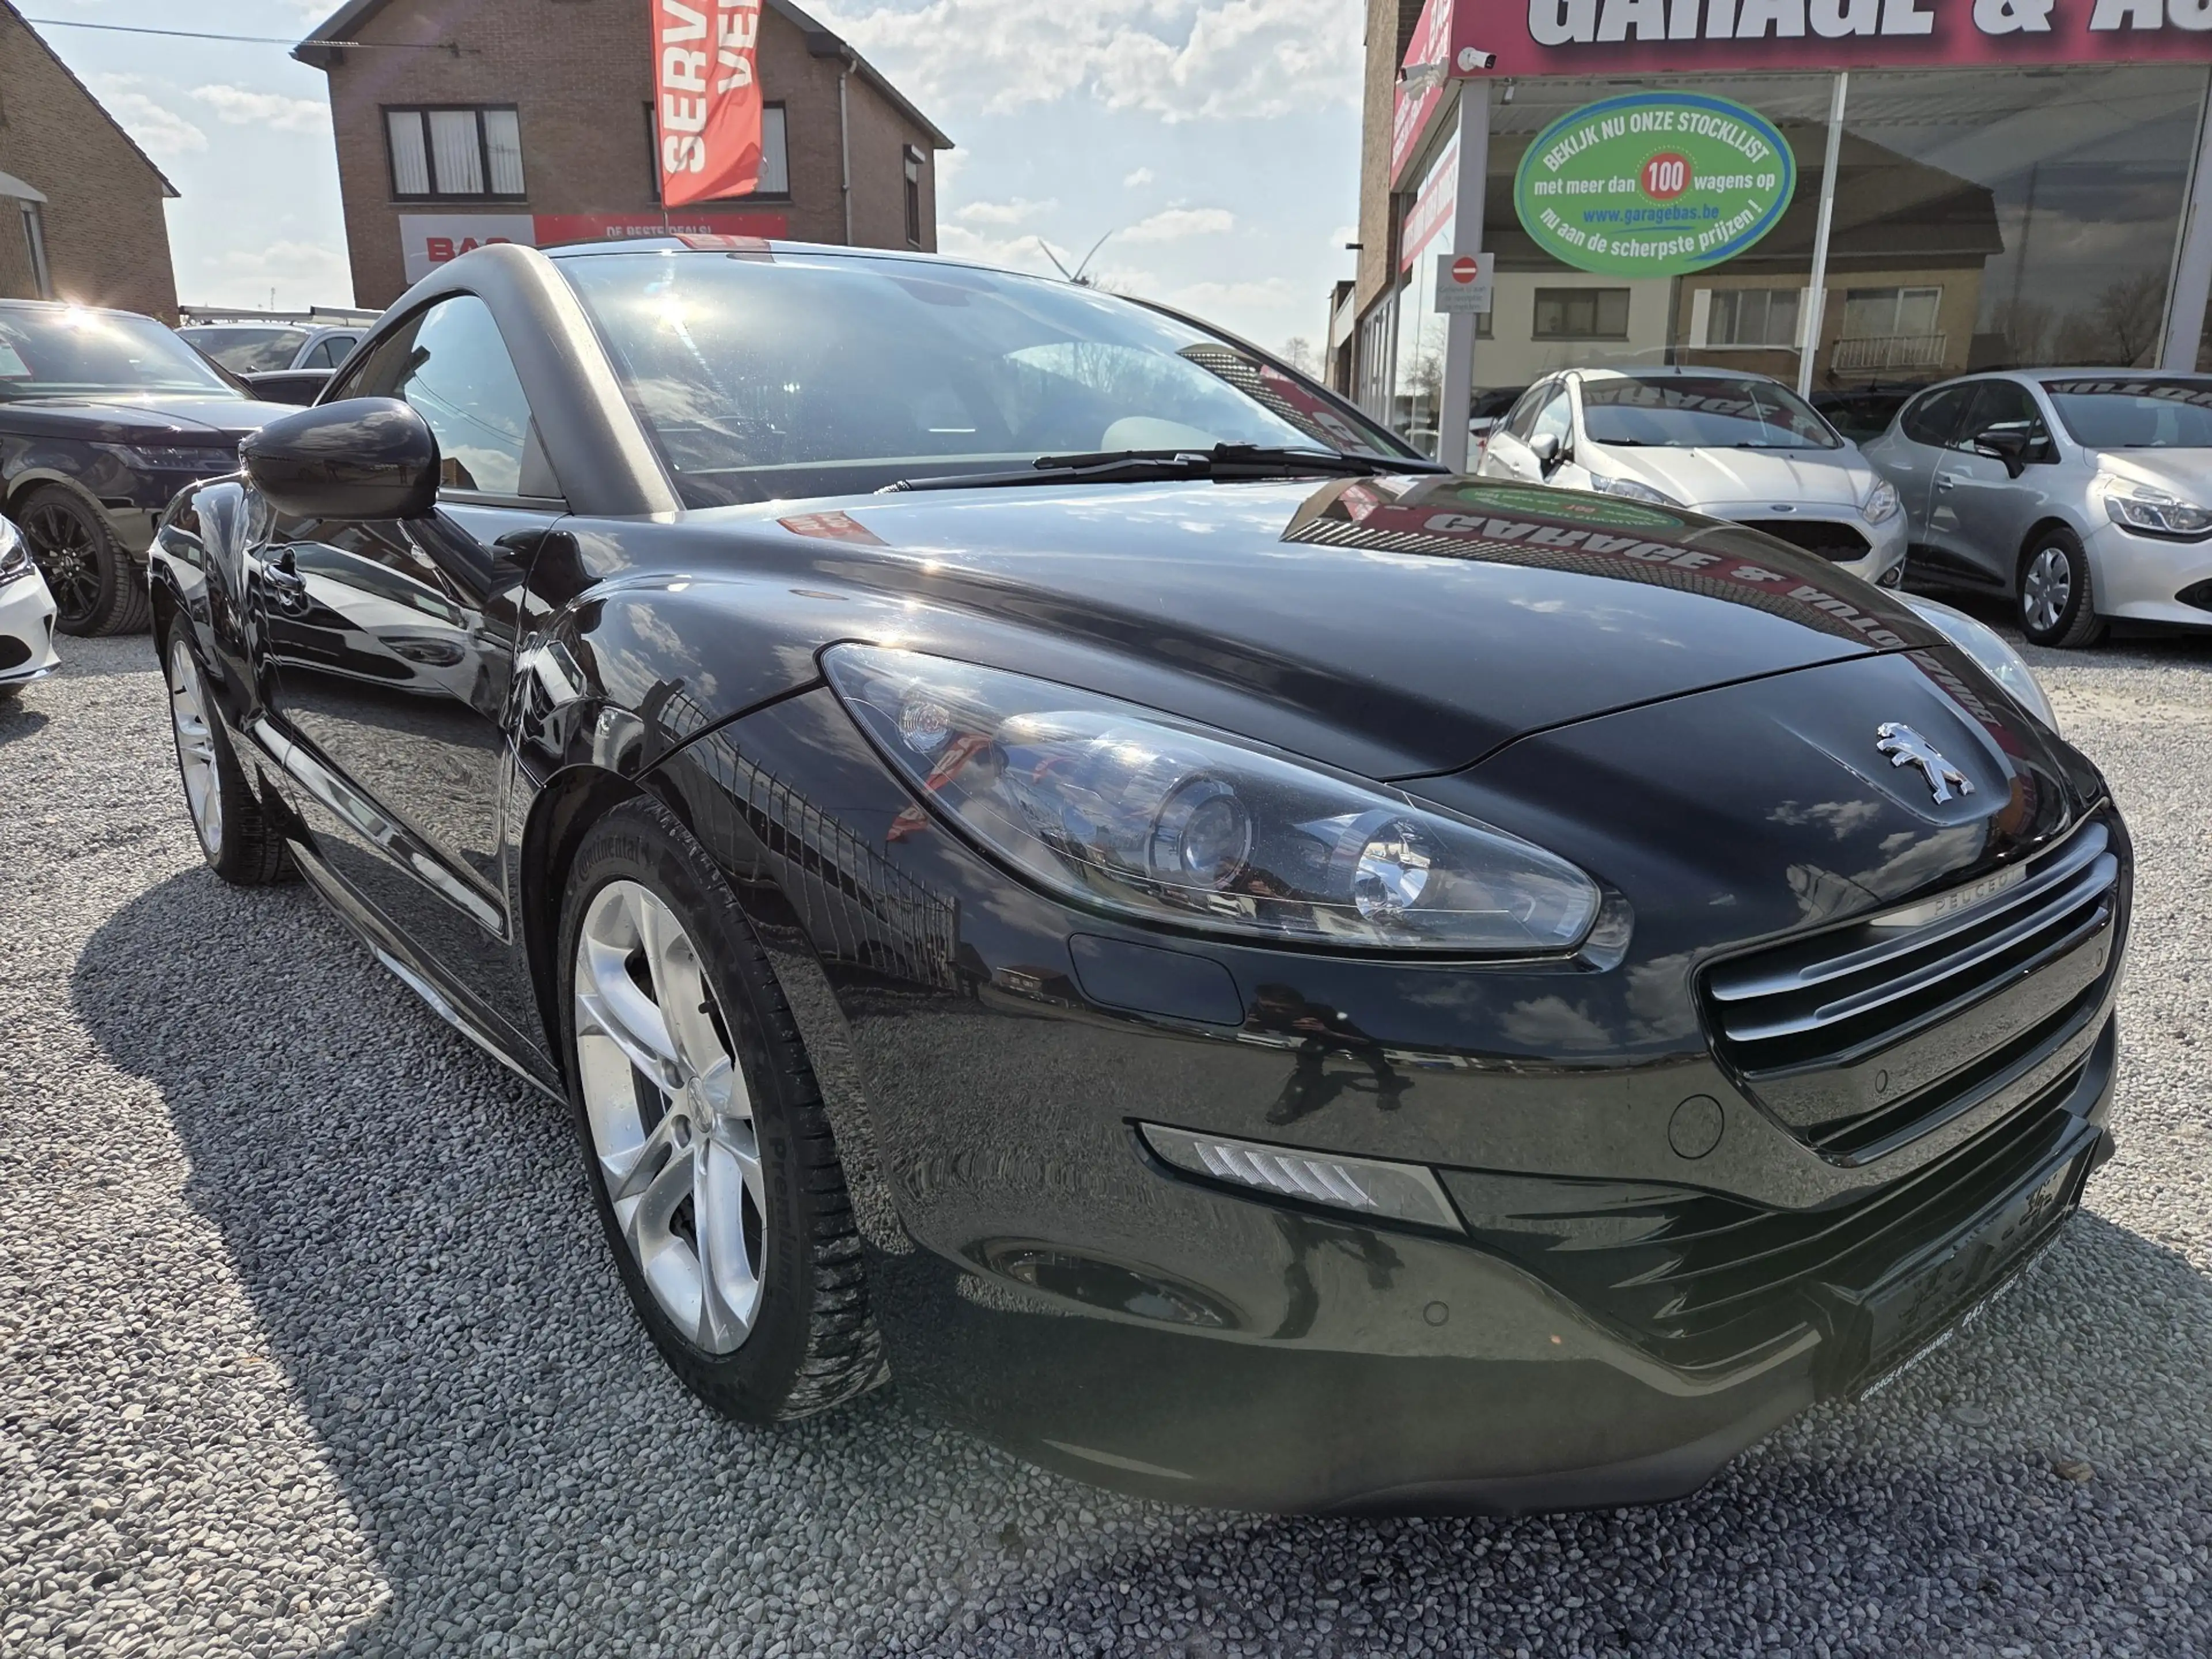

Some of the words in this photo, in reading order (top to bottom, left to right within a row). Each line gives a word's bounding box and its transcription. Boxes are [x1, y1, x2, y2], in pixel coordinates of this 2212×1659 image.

[718, 0, 758, 93] VE
[662, 0, 707, 173] SERV
[1543, 124, 1598, 172] BEKIJK
[1602, 116, 1625, 139] NU
[1630, 111, 1673, 132] ONZE
[1677, 113, 1770, 162] STOCKLIJST
[1535, 176, 1563, 195] met
[1567, 177, 1604, 194] meer
[1608, 175, 1636, 193] dan
[1649, 161, 1684, 191] 100
[1695, 176, 1752, 192] wagens
[1757, 173, 1775, 191] op
[1540, 206, 1558, 230] nu
[1558, 223, 1584, 245] aan
[1588, 233, 1607, 253] de
[1610, 236, 1694, 260] scherpste
[1699, 214, 1755, 252] prijzen
[1584, 204, 1719, 224] www.garagebas.be
[579, 834, 640, 881] Continental
